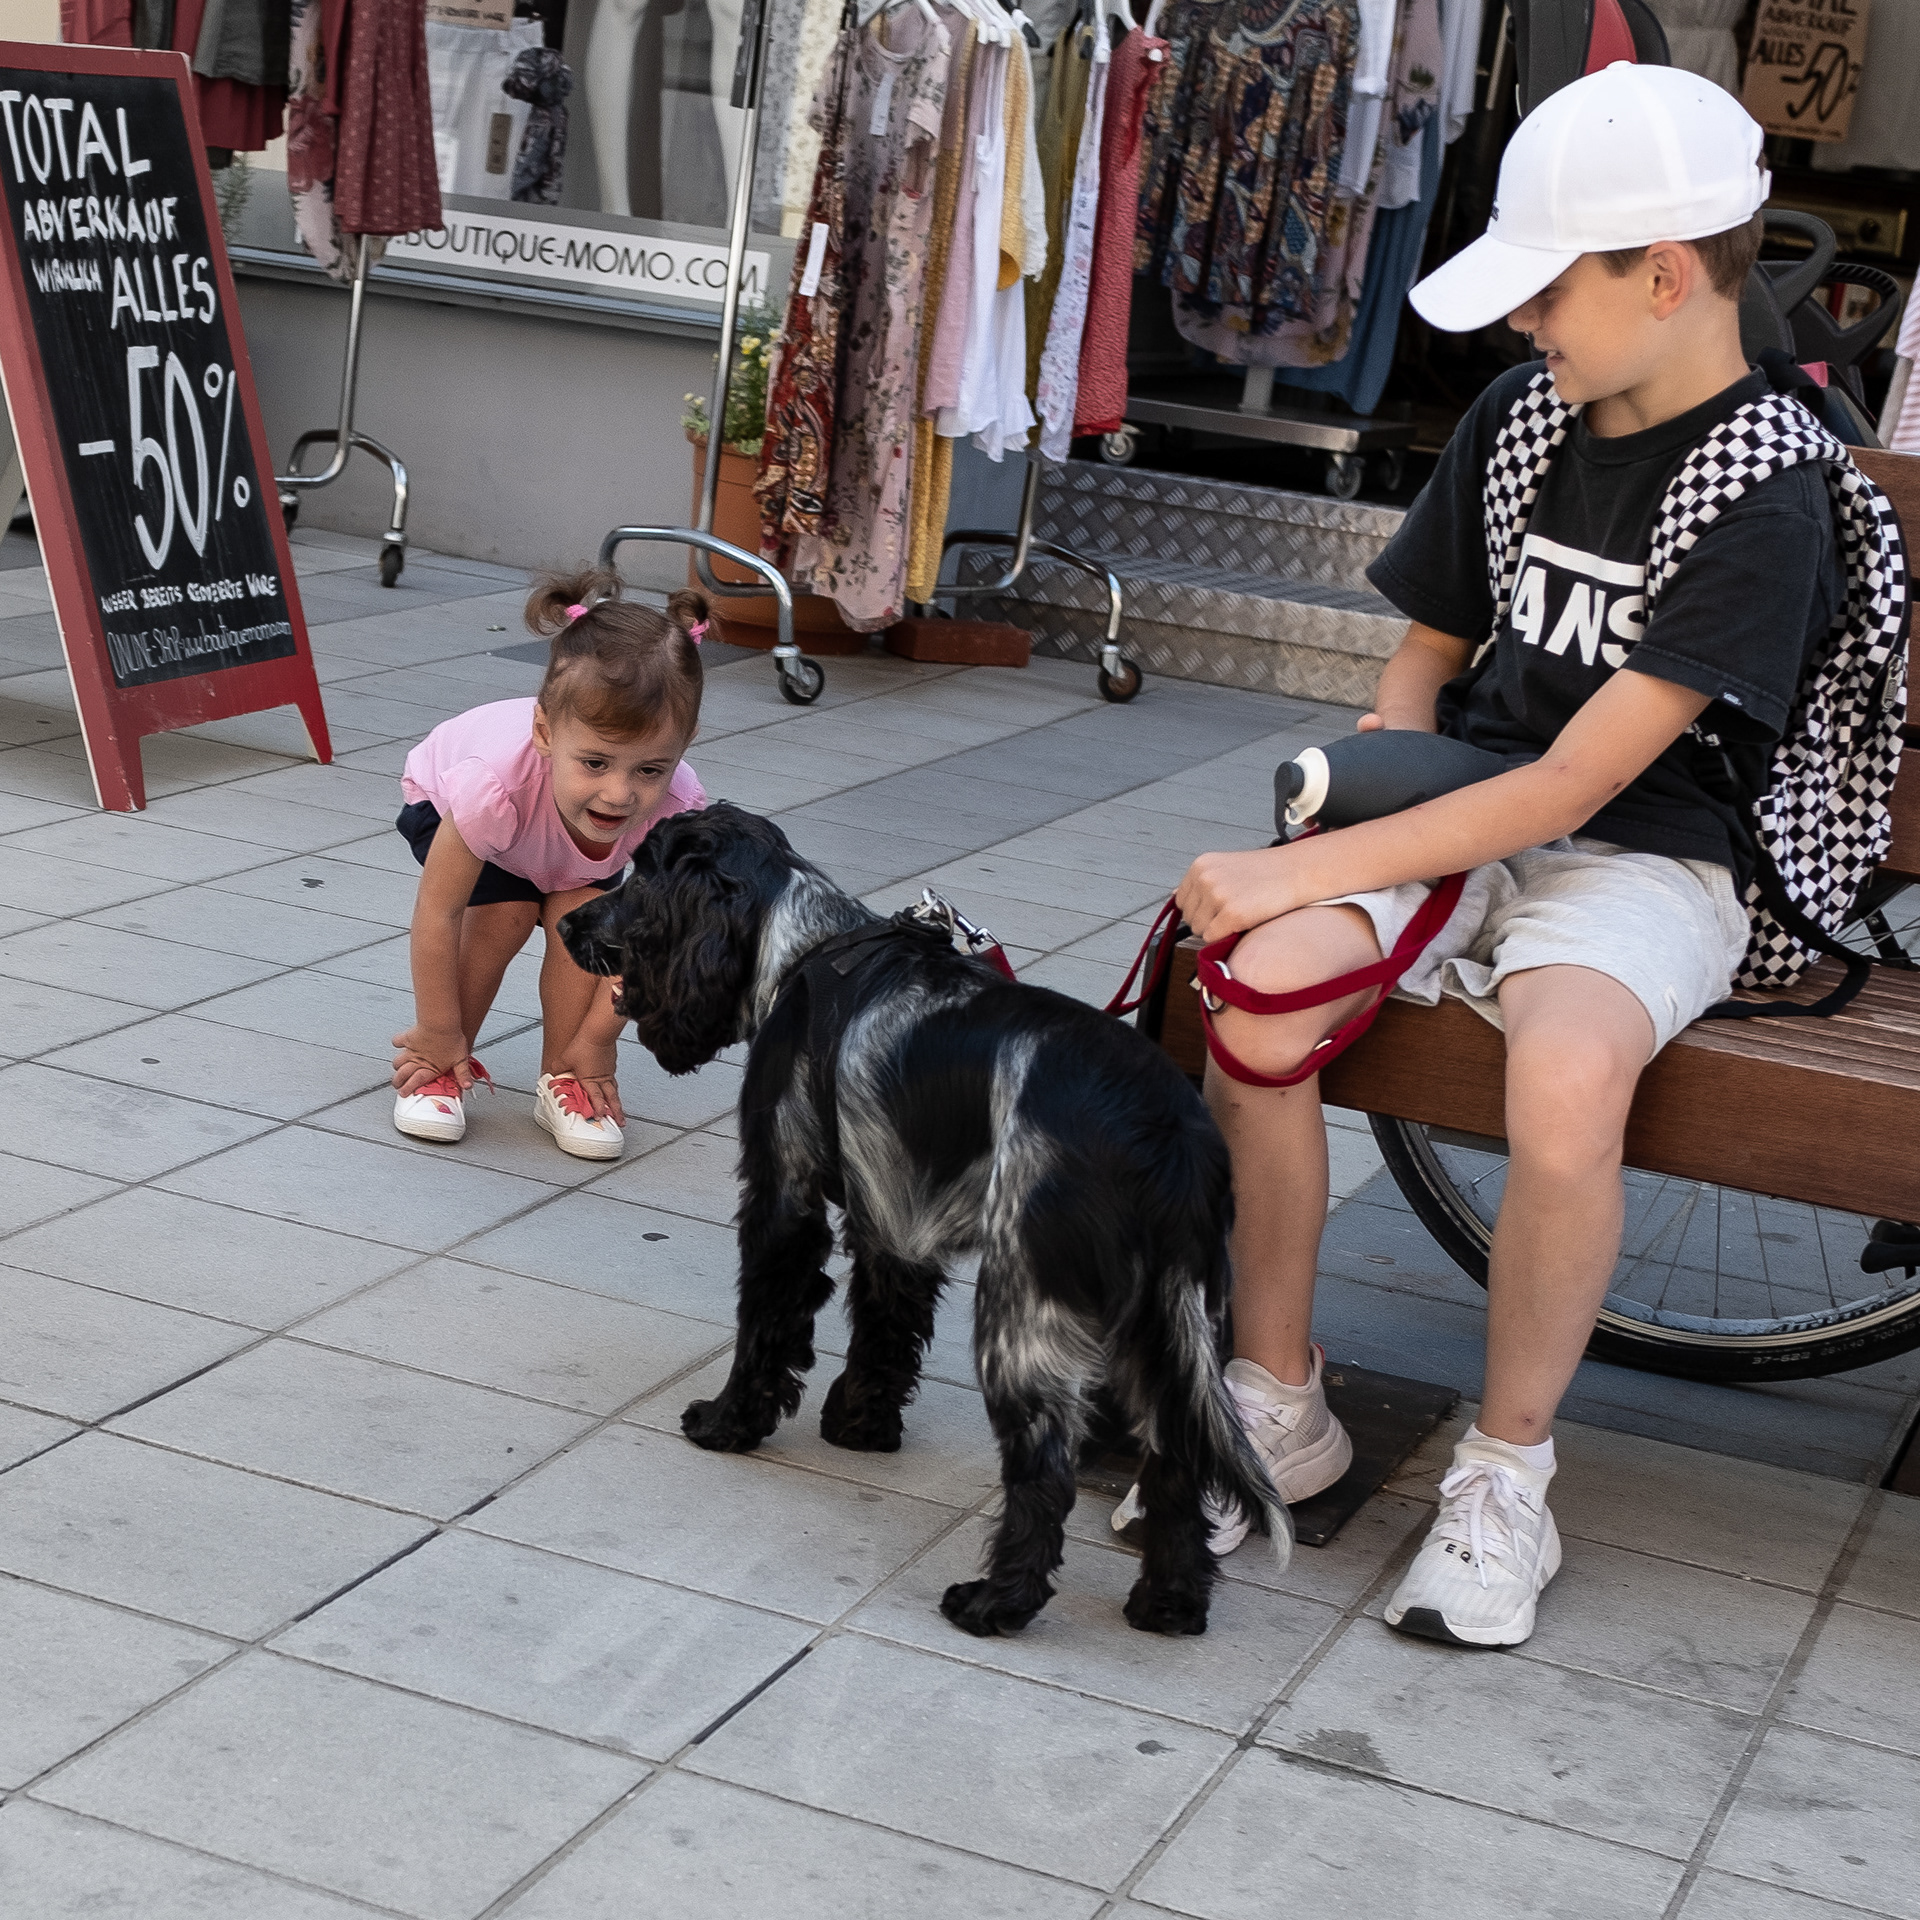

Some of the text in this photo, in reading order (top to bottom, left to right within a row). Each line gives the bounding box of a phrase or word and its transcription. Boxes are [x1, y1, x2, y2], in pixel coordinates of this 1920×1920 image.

[0, 90, 152, 184] TOTAL
[24, 195, 179, 243] ABVERKAUF
[110, 254, 216, 329] ALLES
